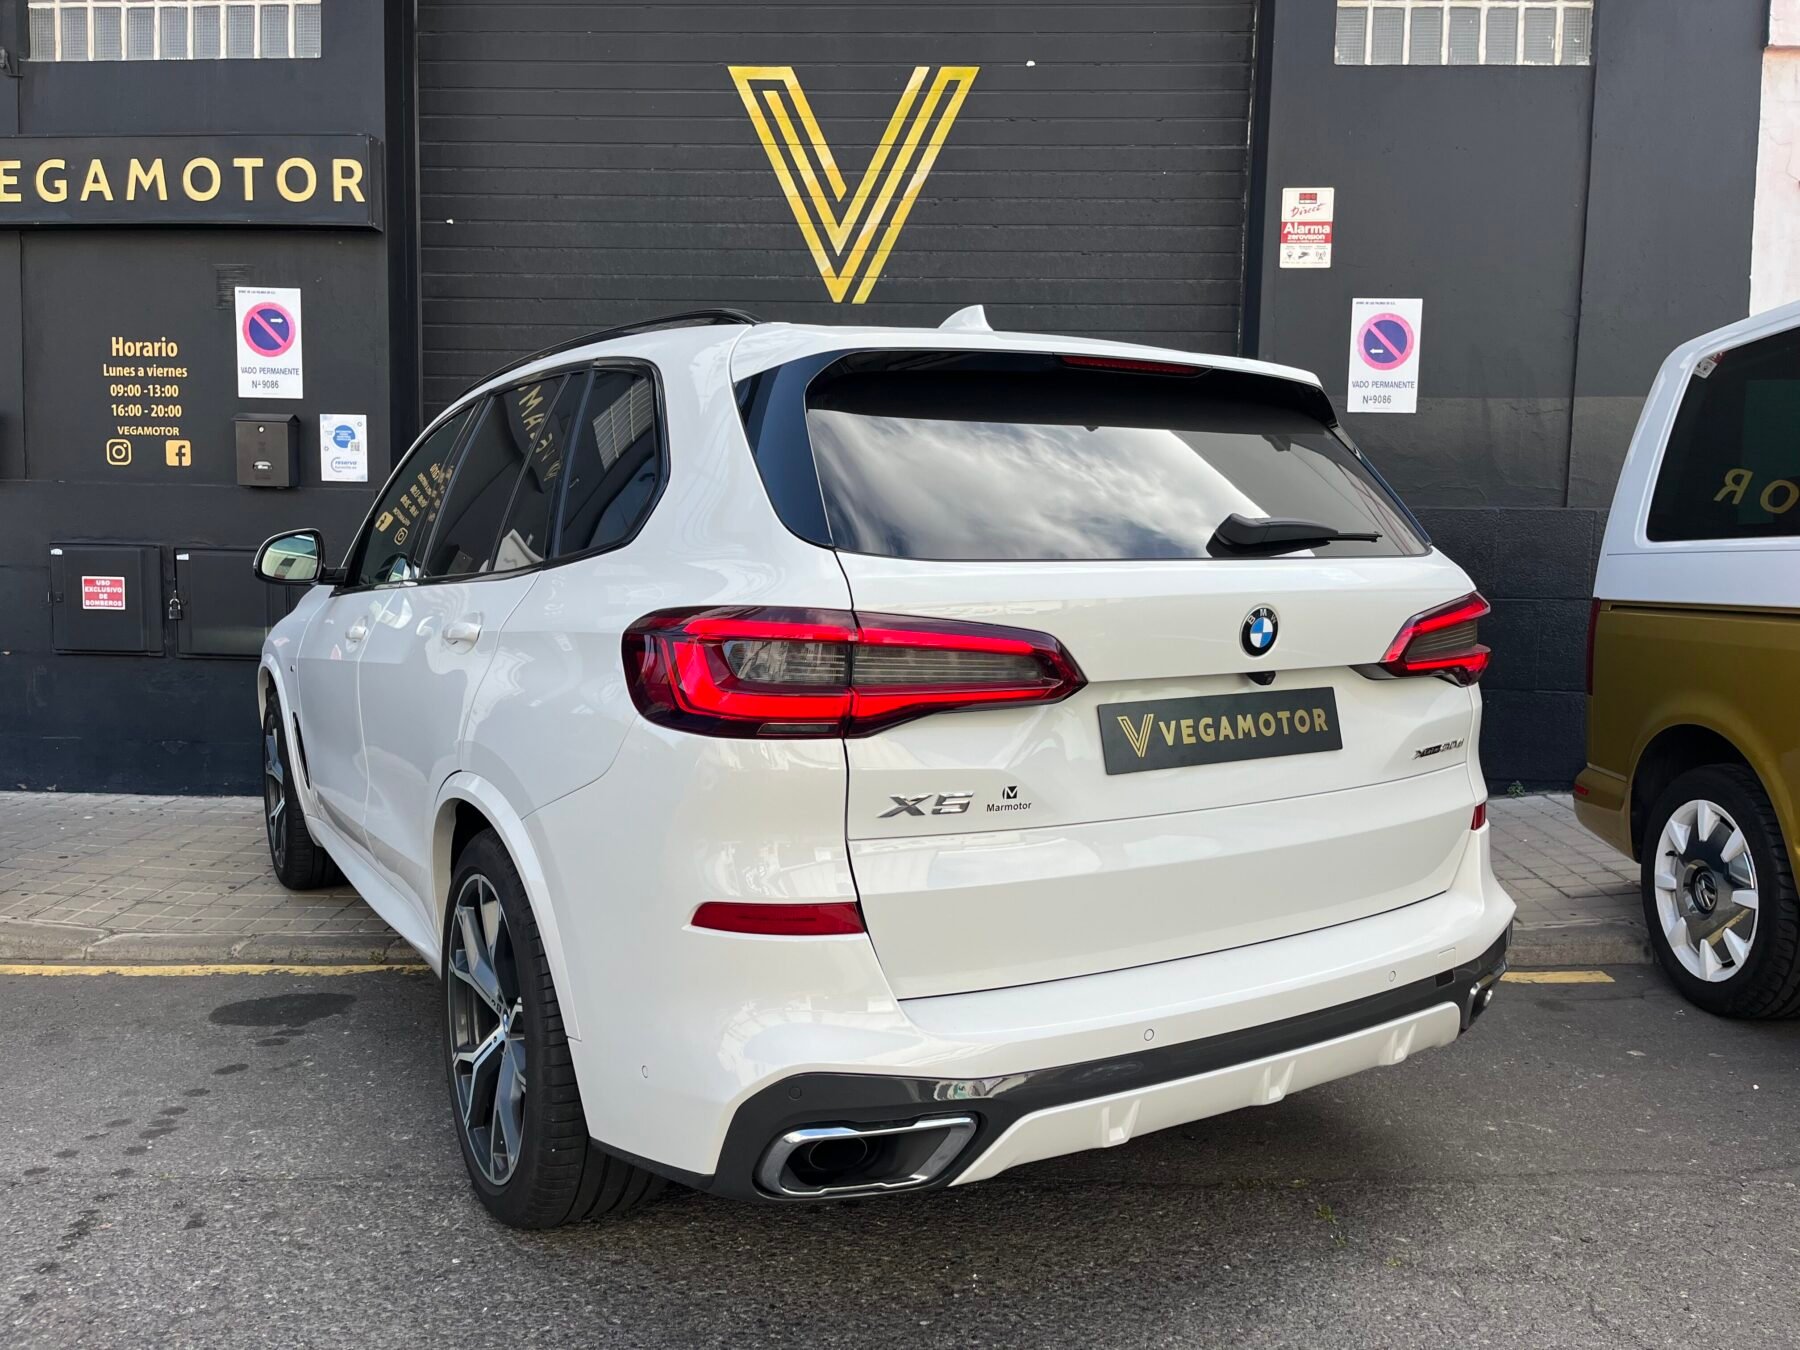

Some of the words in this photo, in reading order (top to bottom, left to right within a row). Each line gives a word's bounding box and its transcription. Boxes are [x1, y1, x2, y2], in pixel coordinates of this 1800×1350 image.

[0, 157, 366, 203] EGAMOTOR
[1283, 222, 1331, 234] Alarma
[111, 336, 178, 357] Horario
[103, 364, 135, 377] Lunes
[137, 367, 145, 377] a
[147, 364, 188, 378] viernes
[241, 366, 257, 374] VADO
[259, 367, 300, 376] PERMANENTE
[110, 384, 141, 397] 09:00
[1352, 380, 1370, 388] VADO
[1371, 380, 1415, 389] PERMANENTE
[111, 404, 142, 417] 16:00
[150, 404, 182, 417] 20:00
[117, 426, 180, 436] VEGAMOTOR
[1158, 708, 1329, 746] VEGAMOTOR
[875, 790, 975, 818] X5
[986, 801, 1032, 812] Marmotor
